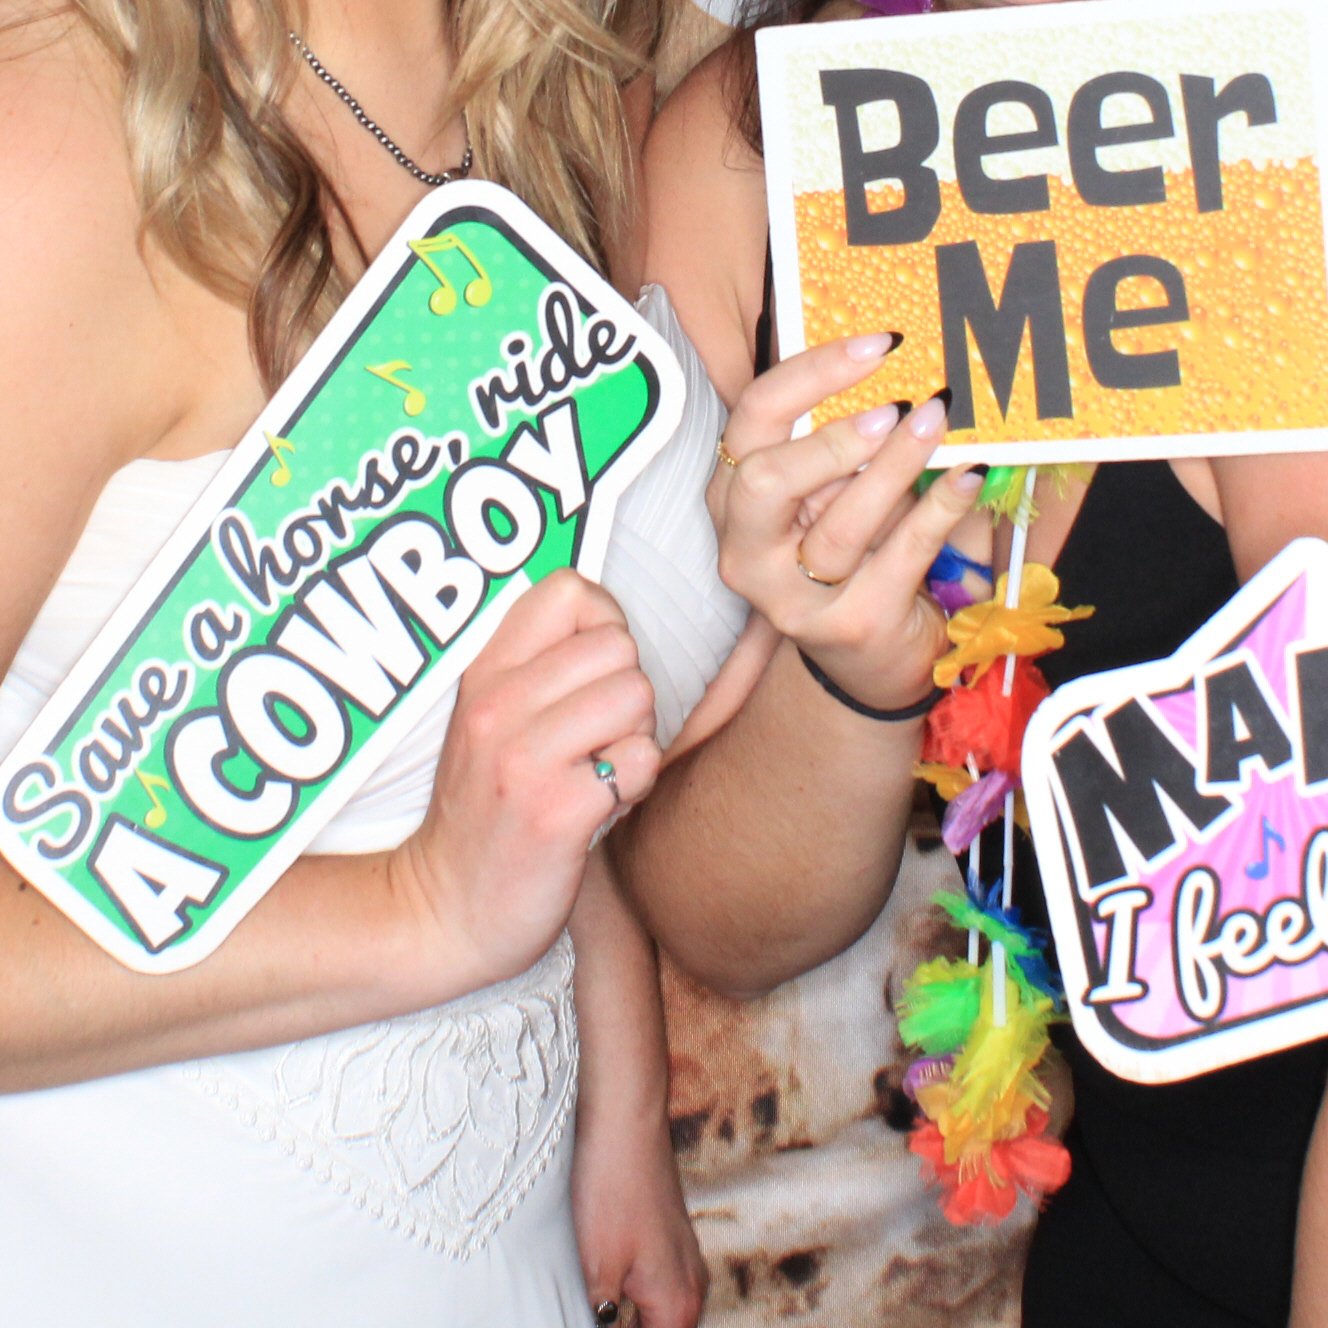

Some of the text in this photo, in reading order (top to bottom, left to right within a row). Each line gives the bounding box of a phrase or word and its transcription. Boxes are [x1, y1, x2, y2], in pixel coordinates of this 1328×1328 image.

[819, 69, 1278, 247] Beer
[934, 239, 1191, 433] Me
[3, 289, 638, 861] Save a horse, ride
[87, 398, 590, 955] A COWBOY
[1082, 887, 1148, 1005] I
